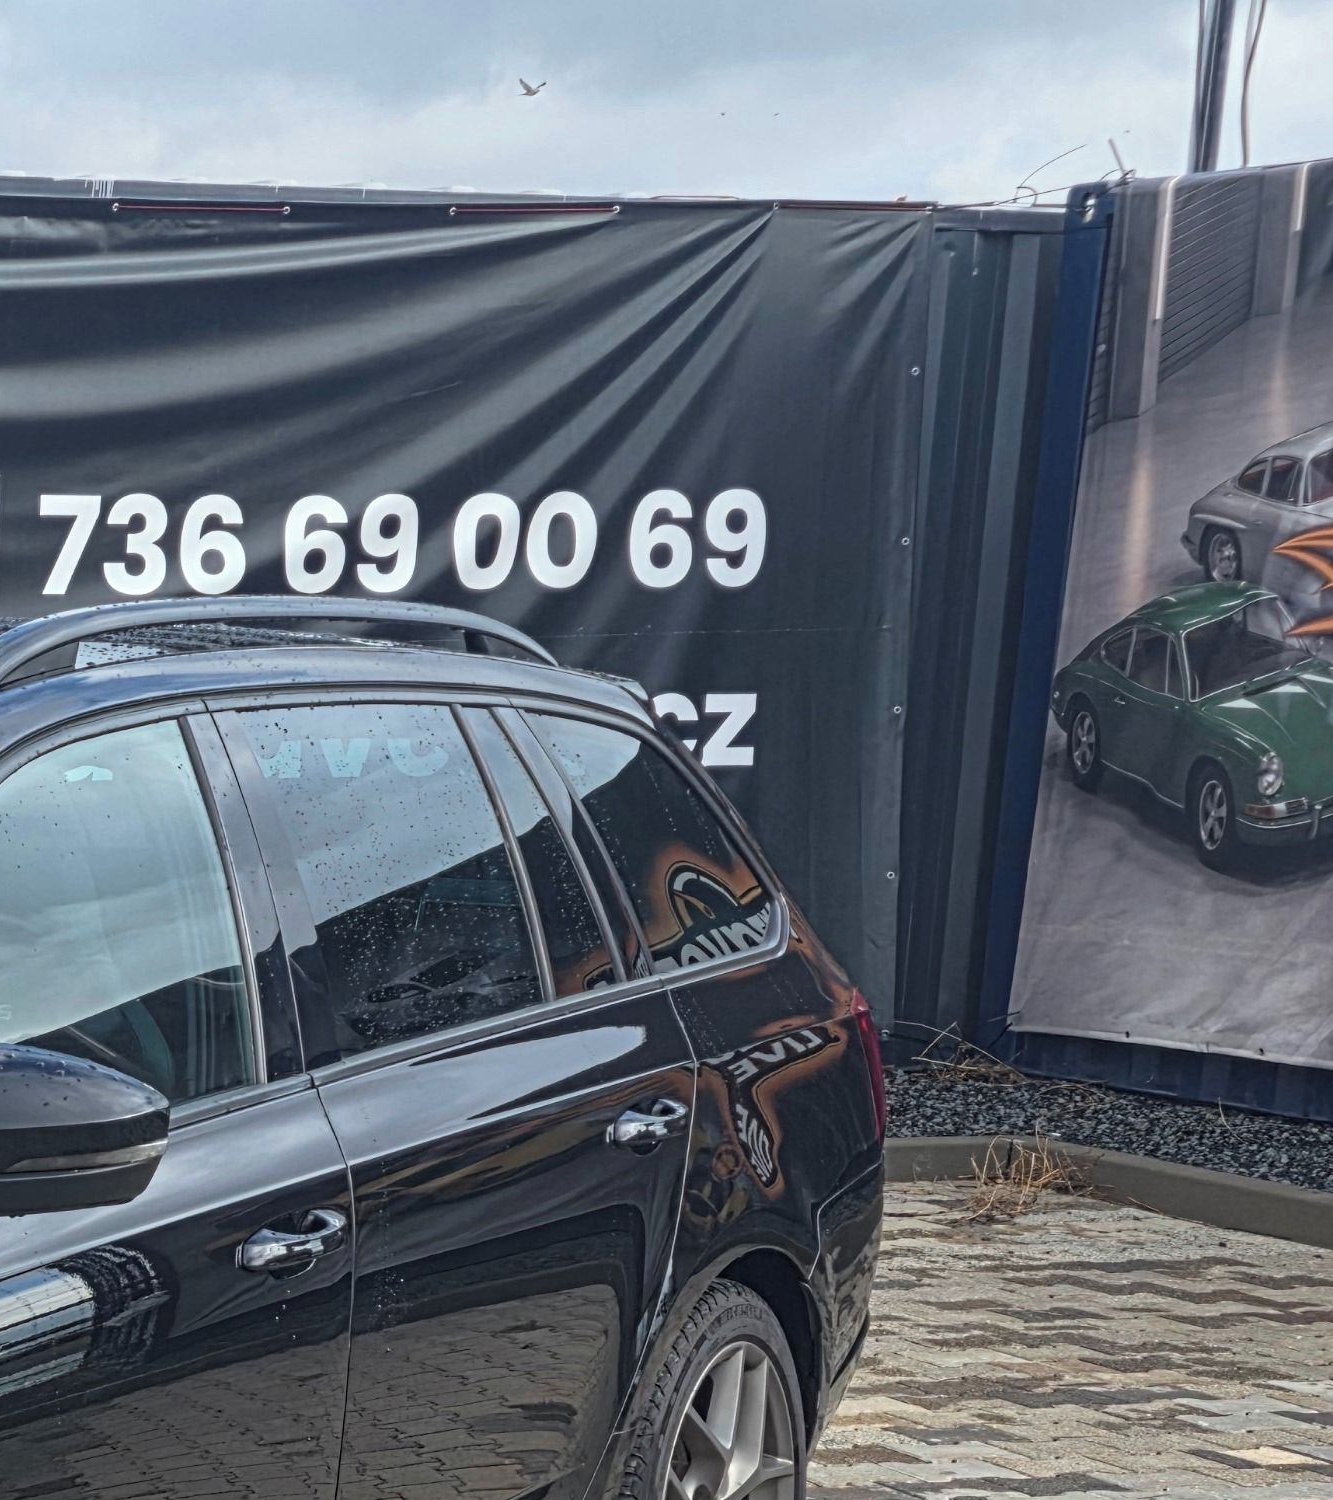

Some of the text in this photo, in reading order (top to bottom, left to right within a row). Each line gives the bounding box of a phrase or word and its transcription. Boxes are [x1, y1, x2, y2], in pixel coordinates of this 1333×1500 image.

[38, 488, 768, 595] 736 69 00 69
